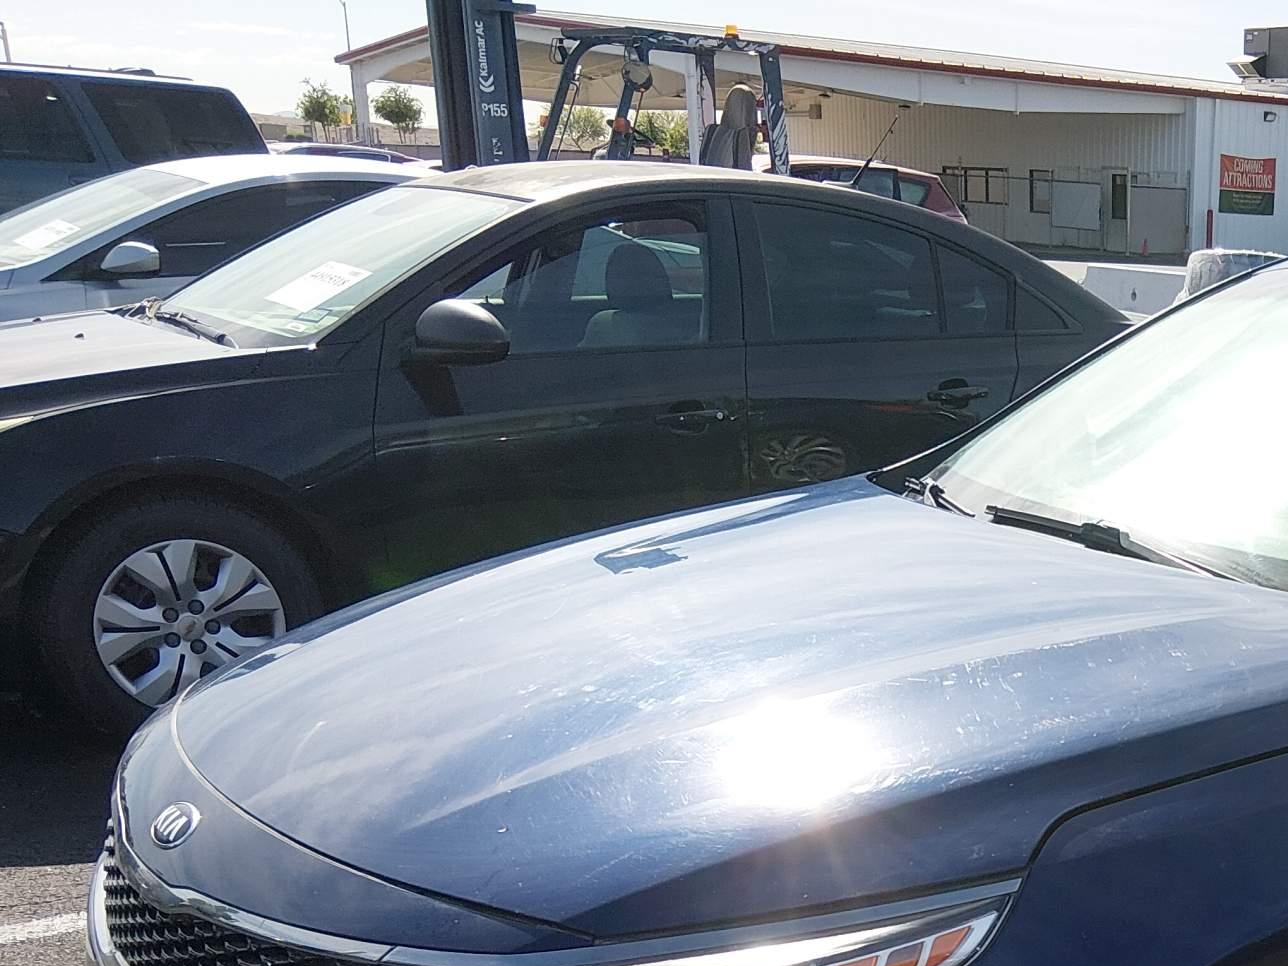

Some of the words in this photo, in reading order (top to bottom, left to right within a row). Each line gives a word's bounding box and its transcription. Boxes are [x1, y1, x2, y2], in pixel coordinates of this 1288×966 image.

[474, 20, 484, 35] AC
[478, 37, 488, 77] Kalmar
[1233, 159, 1264, 174] COMING
[1223, 171, 1273, 189] ATTRACTIONS
[154, 804, 189, 842] KIA
